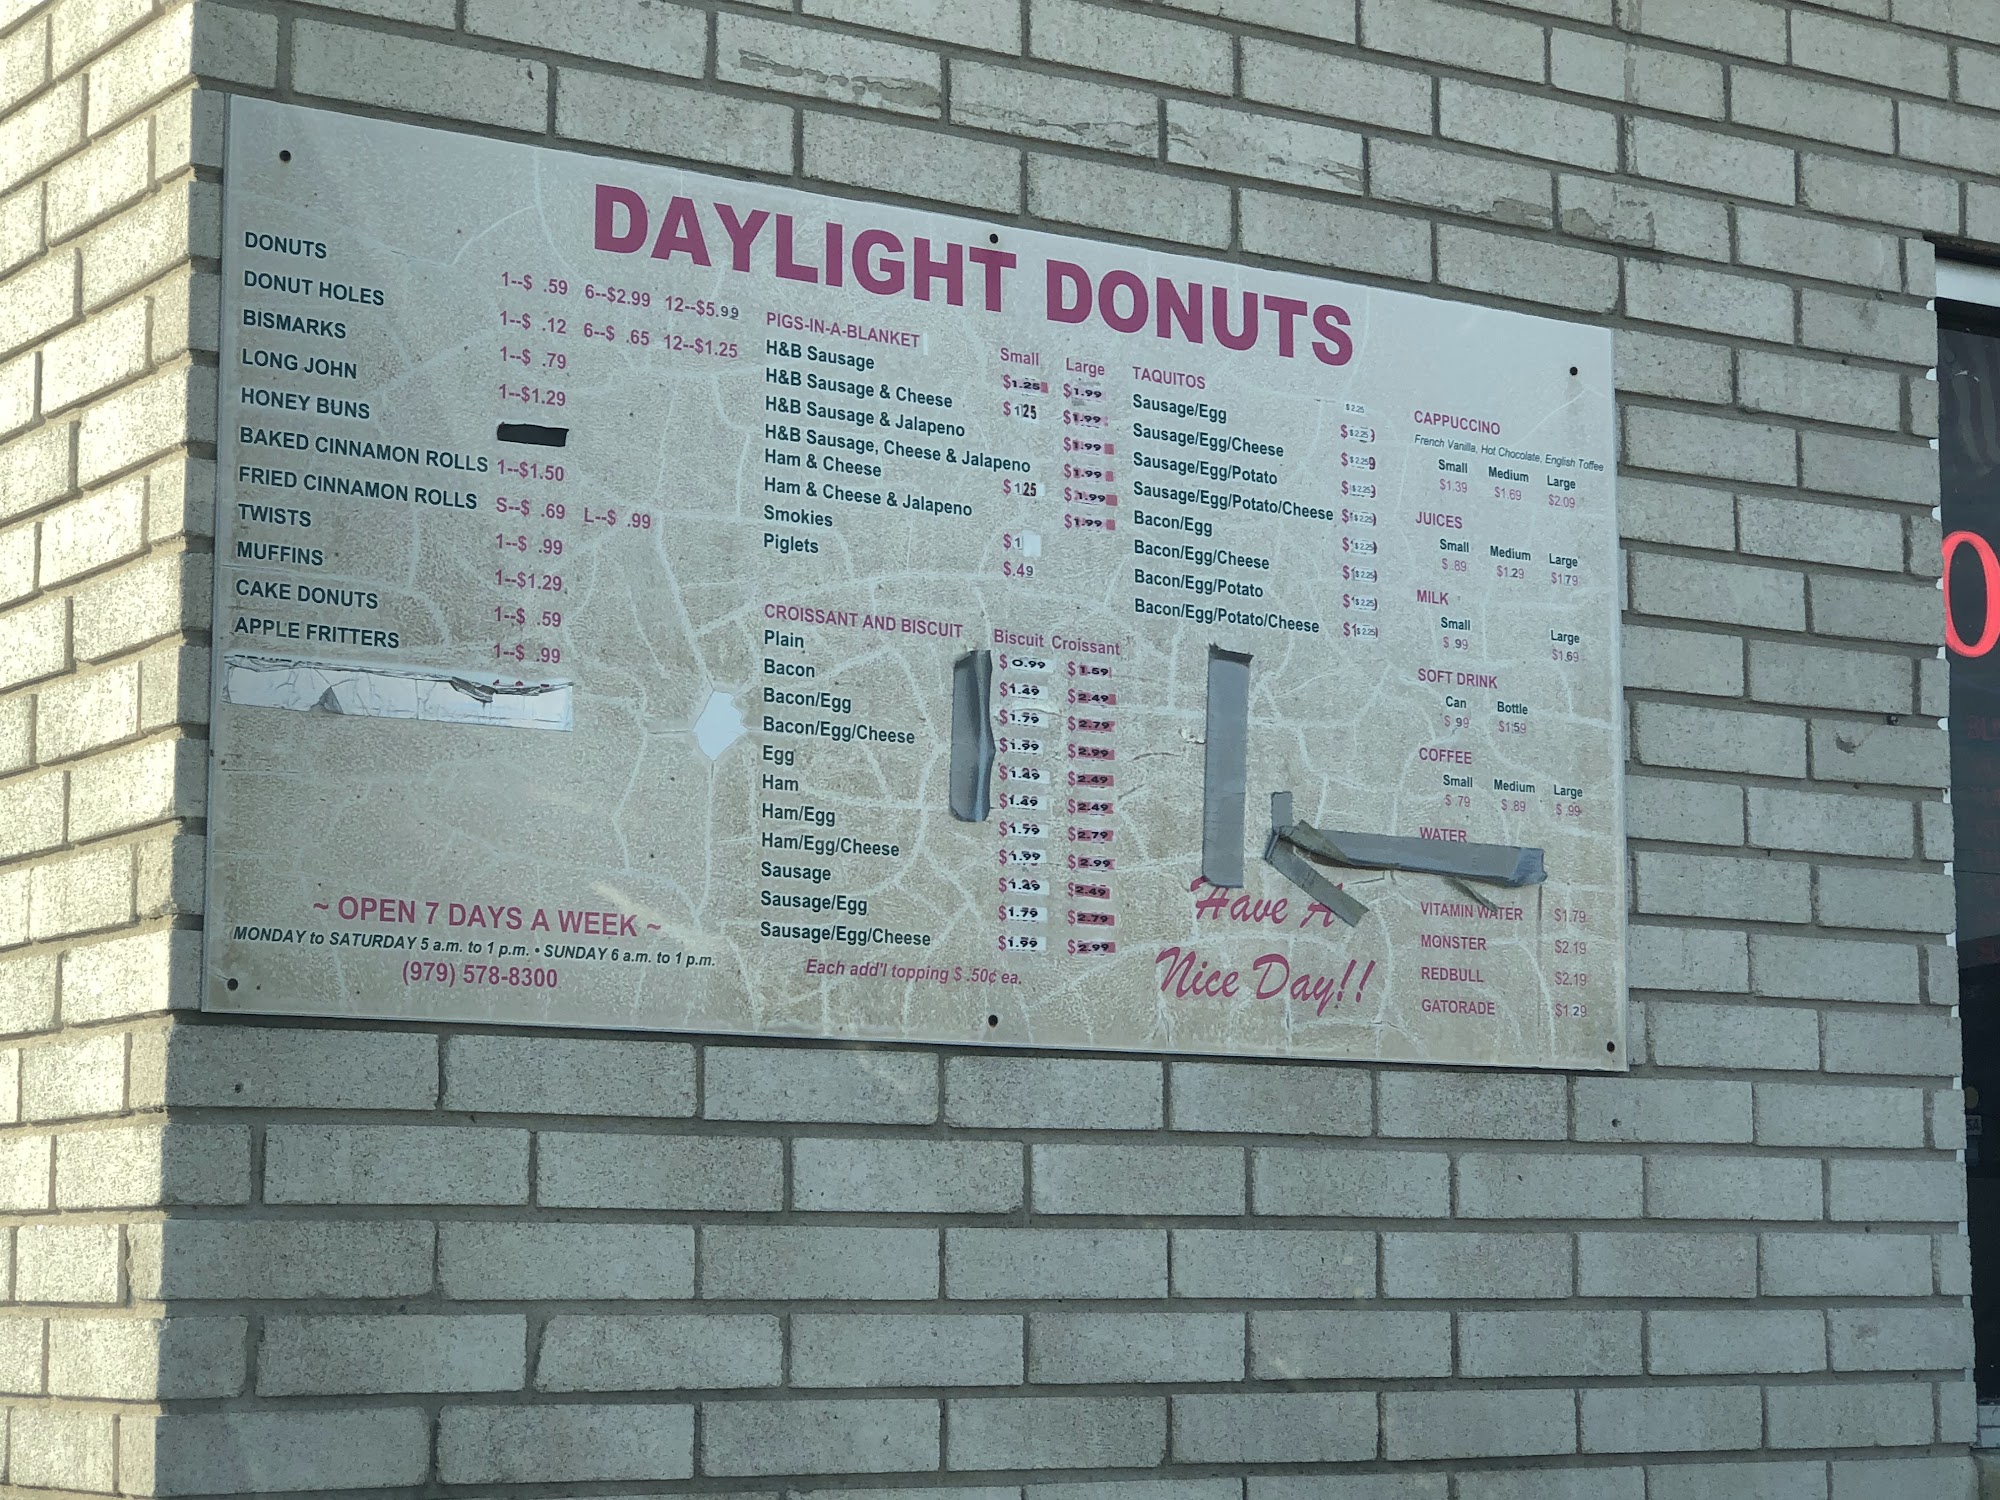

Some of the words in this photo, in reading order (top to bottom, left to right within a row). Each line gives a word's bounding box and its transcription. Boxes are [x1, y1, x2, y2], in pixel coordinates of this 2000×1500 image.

[246, 232, 326, 258] DONUTS
[245, 271, 313, 295] DONUT
[320, 282, 384, 306] HOLES
[595, 182, 1017, 314] DAYLIGHT
[1046, 257, 1355, 368] DONUTS
[244, 309, 346, 338] BISMARKS
[767, 312, 919, 349] PIGS-IN-A-BLANKET
[243, 349, 298, 370] LONG
[304, 358, 356, 379] JOHN
[767, 340, 801, 358] H&B
[808, 346, 874, 371] Sausage
[1001, 348, 1039, 365] Small
[1067, 358, 1104, 377] Large
[767, 368, 801, 386] H&B
[808, 374, 874, 399] Sausage
[880, 382, 890, 399] &
[896, 387, 952, 407] Cheese
[1133, 367, 1205, 389] TAQUITOS
[242, 388, 310, 411] HONEY
[317, 398, 369, 419] BUNS
[1133, 394, 1226, 425] Sausage/Egg
[766, 396, 801, 414] H&B
[807, 402, 874, 426] Sausage
[880, 410, 890, 426] &
[896, 415, 964, 441] Jalapeno
[1415, 411, 1500, 436] CAPPUCCINO
[241, 427, 308, 450] BAKED
[316, 437, 418, 464] CINNAMON
[427, 450, 487, 472] ROLLS
[766, 424, 800, 442] H&B
[807, 430, 878, 456] Sausage,
[884, 440, 940, 462] Cheese
[946, 449, 957, 463] &
[962, 451, 1030, 473] Jalapeno
[1134, 423, 1283, 458] Sausage/Egg/Cheese
[1415, 434, 1444, 447] French
[1448, 439, 1477, 454] Vanilla,
[1481, 445, 1496, 455] Hot
[1499, 447, 1542, 462] Chocolate,
[1545, 454, 1575, 467] English
[1579, 459, 1603, 471] Toffee
[766, 449, 800, 467] Ham
[806, 454, 817, 469] &
[824, 456, 881, 476] Cheese
[1134, 451, 1278, 486] Sausage/Egg/Potato
[1439, 459, 1467, 473] Small
[1489, 466, 1528, 482] Medium
[1547, 475, 1575, 490] Large
[240, 467, 296, 488] FRIED
[304, 475, 407, 501] CINNAMON
[415, 487, 477, 509] ROLLS
[765, 477, 800, 495] Ham
[806, 482, 817, 497] &
[823, 484, 881, 505] Cheese
[887, 492, 897, 506] &
[903, 495, 972, 516] Jalapeno
[1440, 479, 1467, 493] $1.39
[1134, 480, 1333, 522] Sausage/Egg/Potato/Cheese
[238, 504, 311, 529] TWISTS
[764, 505, 832, 527] Smokies
[1135, 510, 1212, 537] Bacon/Egg
[1416, 512, 1462, 529] JUICES
[238, 542, 323, 565] MUFFINS
[764, 533, 818, 554] Piglets
[1135, 540, 1269, 569] Bacon/Egg/Cheese
[1440, 539, 1469, 552] Small
[1490, 546, 1530, 560] Medium
[1549, 553, 1577, 568] Large
[236, 579, 290, 599] CAKE
[298, 586, 377, 609] DONUTS
[1135, 569, 1263, 597] Bacon/Egg/Potato
[1417, 590, 1448, 605] MILK
[765, 604, 858, 627] CROISSANT
[863, 611, 896, 631] AND
[902, 618, 963, 638] BISCUIT
[1135, 598, 1319, 632] Bacon/Egg/Potato/Cheese
[235, 617, 299, 638] APPLE
[307, 624, 398, 648] FRITTERS
[765, 630, 803, 649] Plain
[994, 629, 1044, 647] Biscuit
[1052, 635, 1120, 655] Croissant
[1441, 617, 1470, 630] Small
[1551, 630, 1579, 645] Large
[764, 659, 815, 678] Bacon
[1418, 668, 1452, 683] SOFT
[1457, 673, 1497, 689] DRINK
[764, 688, 851, 713] Bacon/Egg
[1446, 696, 1466, 708] Can
[1498, 701, 1527, 714] Bottle
[764, 716, 914, 744] Bacon/Egg/Cheese
[763, 745, 794, 766] Egg
[1419, 748, 1471, 764] COFFEE
[763, 774, 798, 791] Ham
[1443, 775, 1472, 787] Small
[1494, 779, 1535, 792] Medium
[1554, 785, 1582, 799] Large
[763, 803, 835, 827] Ham/Egg
[762, 832, 899, 857] Ham/Egg/Cheese
[1420, 827, 1466, 842] WATER
[762, 862, 831, 883] Sausage
[339, 896, 415, 924] OPEN
[426, 902, 439, 924] 7
[449, 903, 522, 930] DAYS
[531, 909, 550, 931] A
[558, 909, 637, 937] WEEK
[761, 891, 867, 915] Sausage/Egg
[1421, 902, 1473, 921] VITAMIN
[1554, 908, 1588, 923] $1.79
[234, 926, 307, 945] MONDAY
[310, 932, 324, 945] to
[330, 932, 417, 950] SATURDAY
[421, 937, 429, 950] 5
[433, 940, 463, 952] a.m.
[468, 940, 481, 953] to
[488, 941, 493, 954] 1
[499, 944, 530, 958] p.m.
[544, 944, 608, 962] SUNDAY
[612, 948, 619, 961] 6
[623, 951, 652, 963] a.m.
[657, 951, 670, 965] to
[676, 952, 681, 965] 1
[686, 954, 716, 968] p.m.
[761, 922, 930, 947] Sausage/Egg/Cheese
[1421, 935, 1486, 951] MONSTER
[1555, 940, 1586, 955] $2.19
[403, 961, 455, 987] (979)
[464, 964, 557, 988] 578-8300
[806, 959, 845, 975] Each
[892, 965, 949, 984] topping
[1001, 972, 1022, 985] ea.
[1156, 947, 1239, 1000] Nice
[1253, 954, 1376, 1016] Day!!
[1422, 967, 1484, 983] REDBULL
[1555, 972, 1588, 986] $2.19
[1422, 999, 1495, 1015] GATORADE
